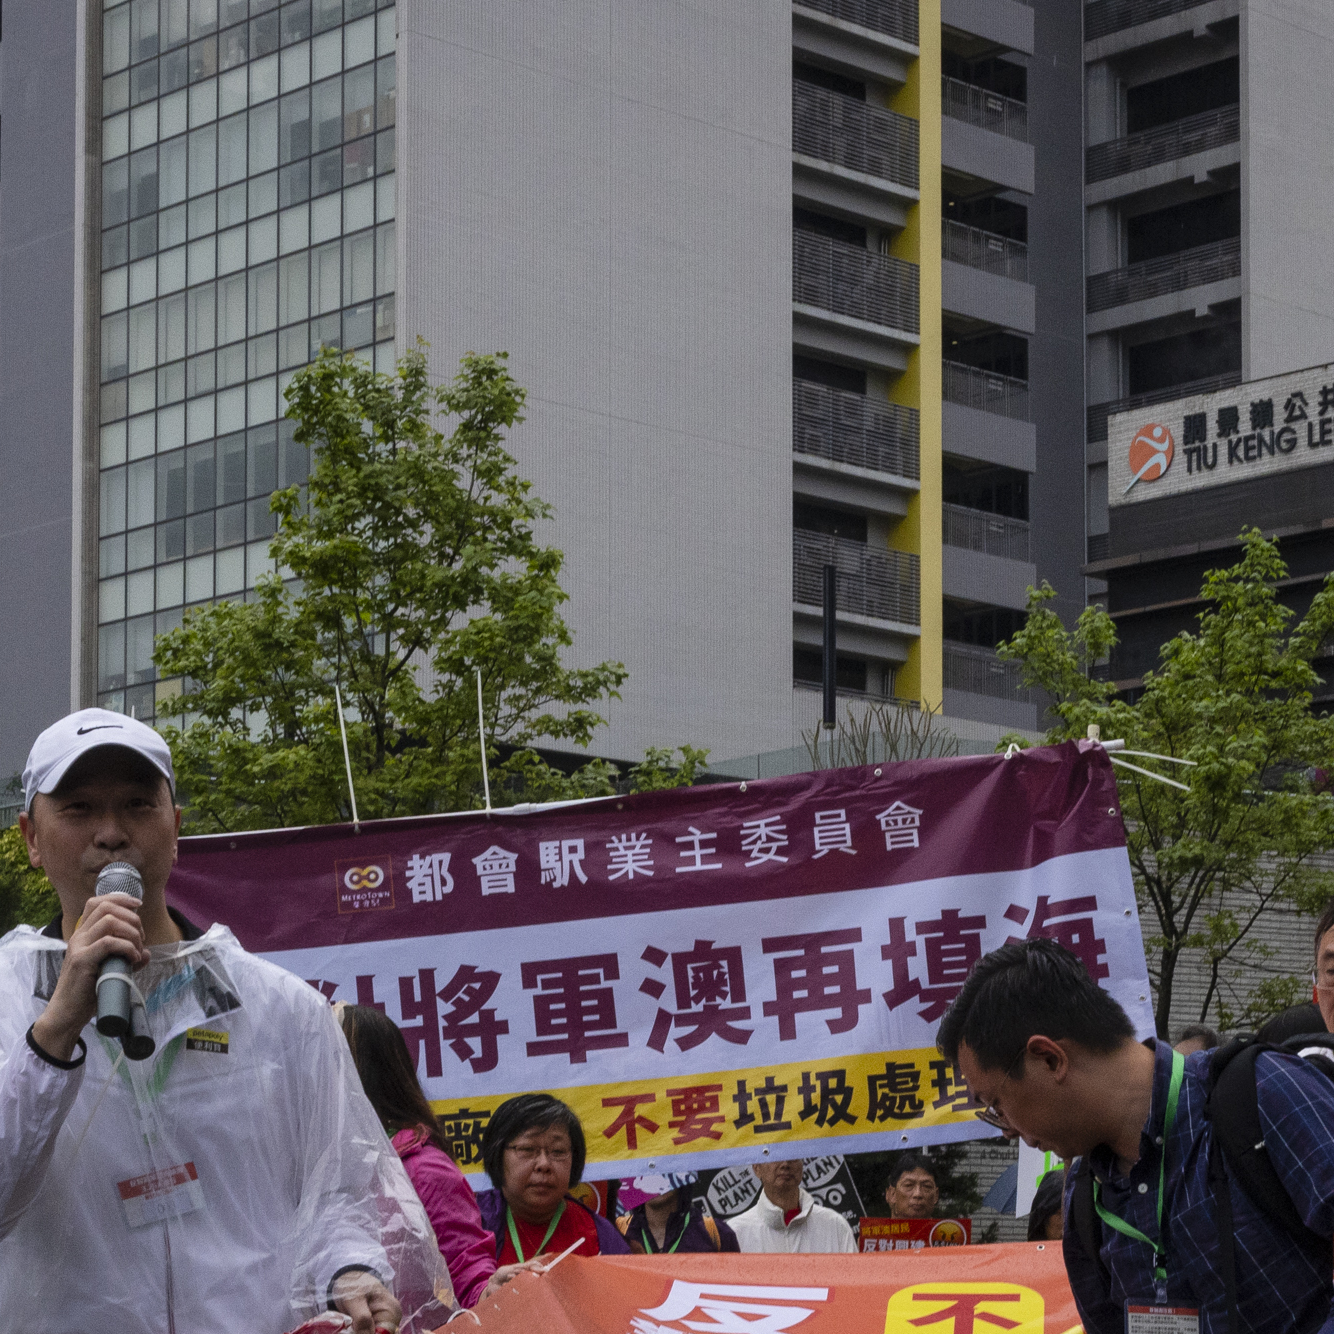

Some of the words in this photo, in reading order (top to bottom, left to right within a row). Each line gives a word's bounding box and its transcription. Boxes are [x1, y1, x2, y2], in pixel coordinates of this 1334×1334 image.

[1183, 441, 1218, 475] TIU
[1227, 426, 1298, 466] KENG
[305, 895, 1110, 1078] 將軍澳再填海
[712, 1170, 742, 1195] KILL
[717, 1178, 758, 1214] PLANT
